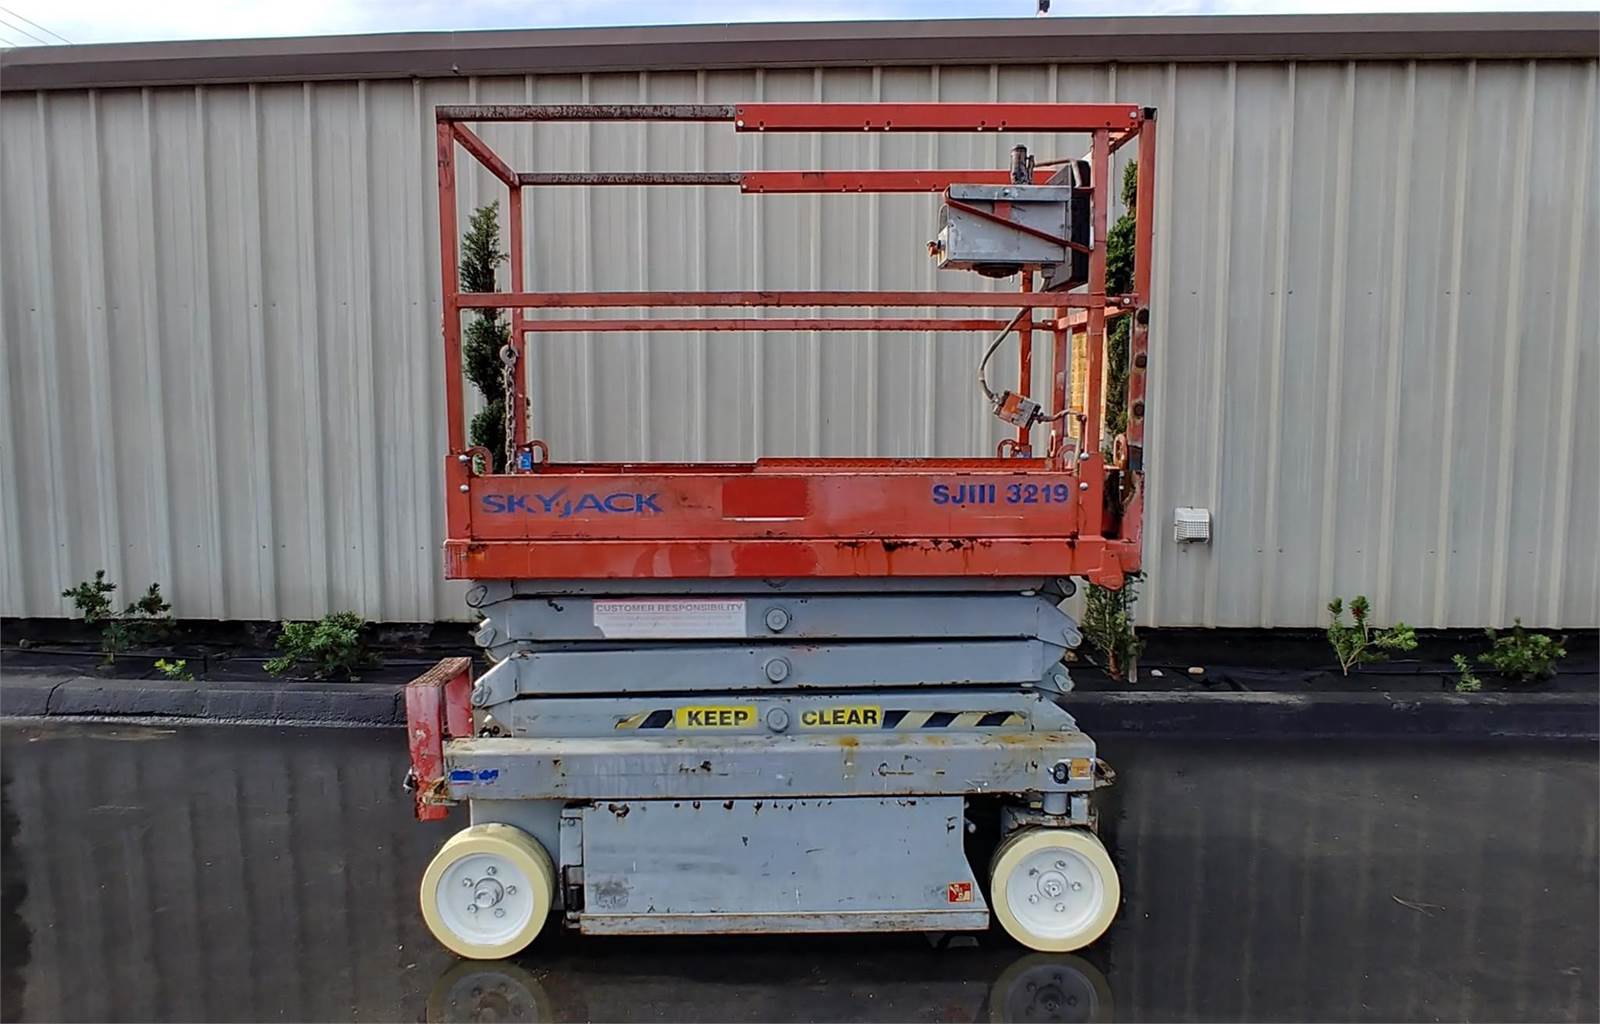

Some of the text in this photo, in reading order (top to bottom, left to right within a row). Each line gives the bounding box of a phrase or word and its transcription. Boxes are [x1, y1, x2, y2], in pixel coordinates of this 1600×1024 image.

[481, 487, 664, 518] SKYJACK
[932, 484, 1069, 505] SJIII 3219
[596, 603, 743, 612] CUSTOMER RESPONSIBILITY
[687, 709, 878, 726] KEEP CLEAR
